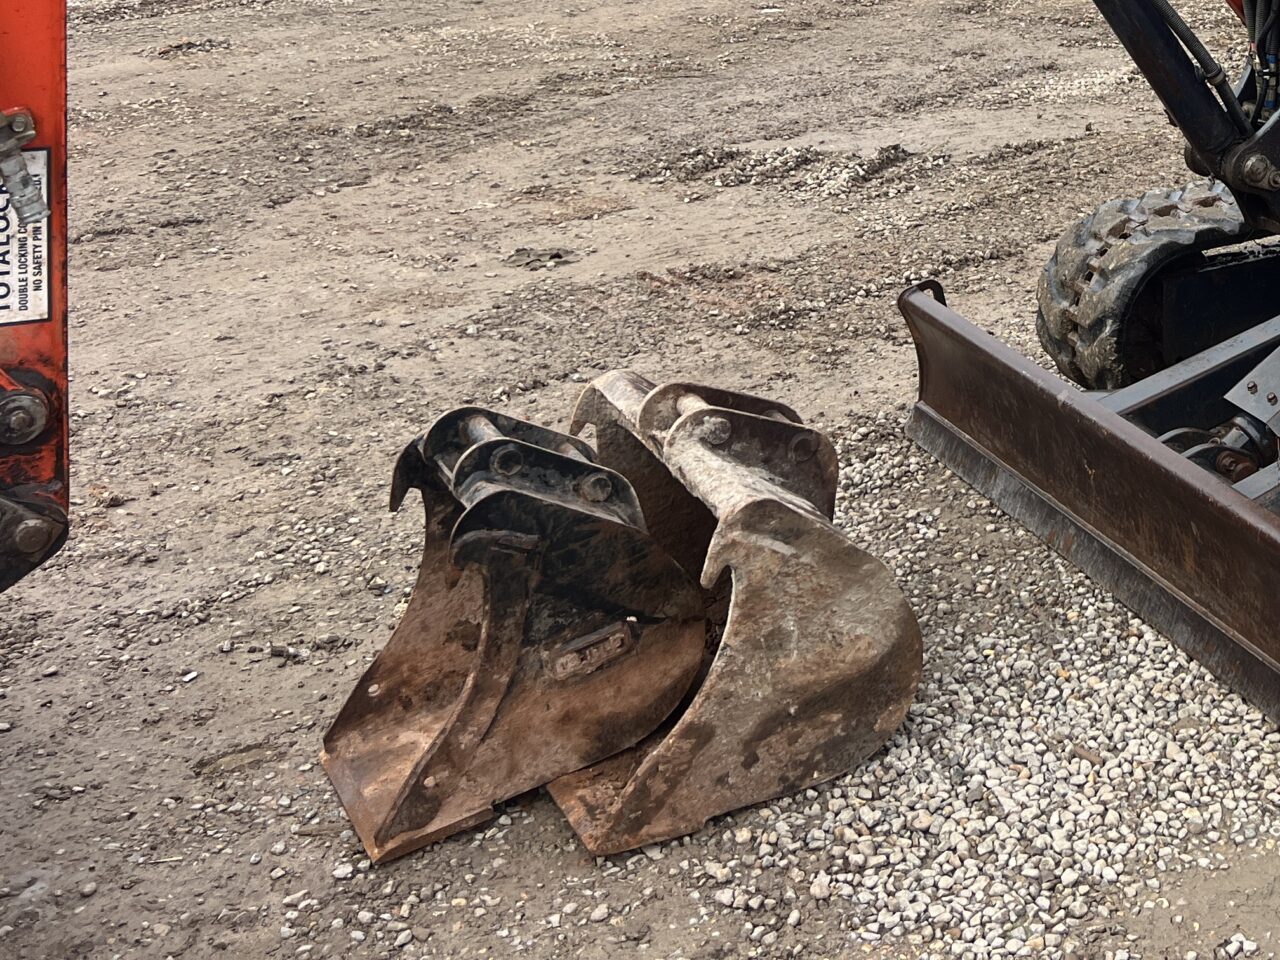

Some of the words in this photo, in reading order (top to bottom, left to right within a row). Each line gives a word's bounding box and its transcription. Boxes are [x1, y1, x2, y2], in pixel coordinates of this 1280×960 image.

[32, 226, 42, 241] PIN
[18, 236, 28, 275] LOCKING
[32, 244, 42, 277] SAFETY
[18, 277, 29, 311] DOUBLE
[32, 279, 42, 291] NO
